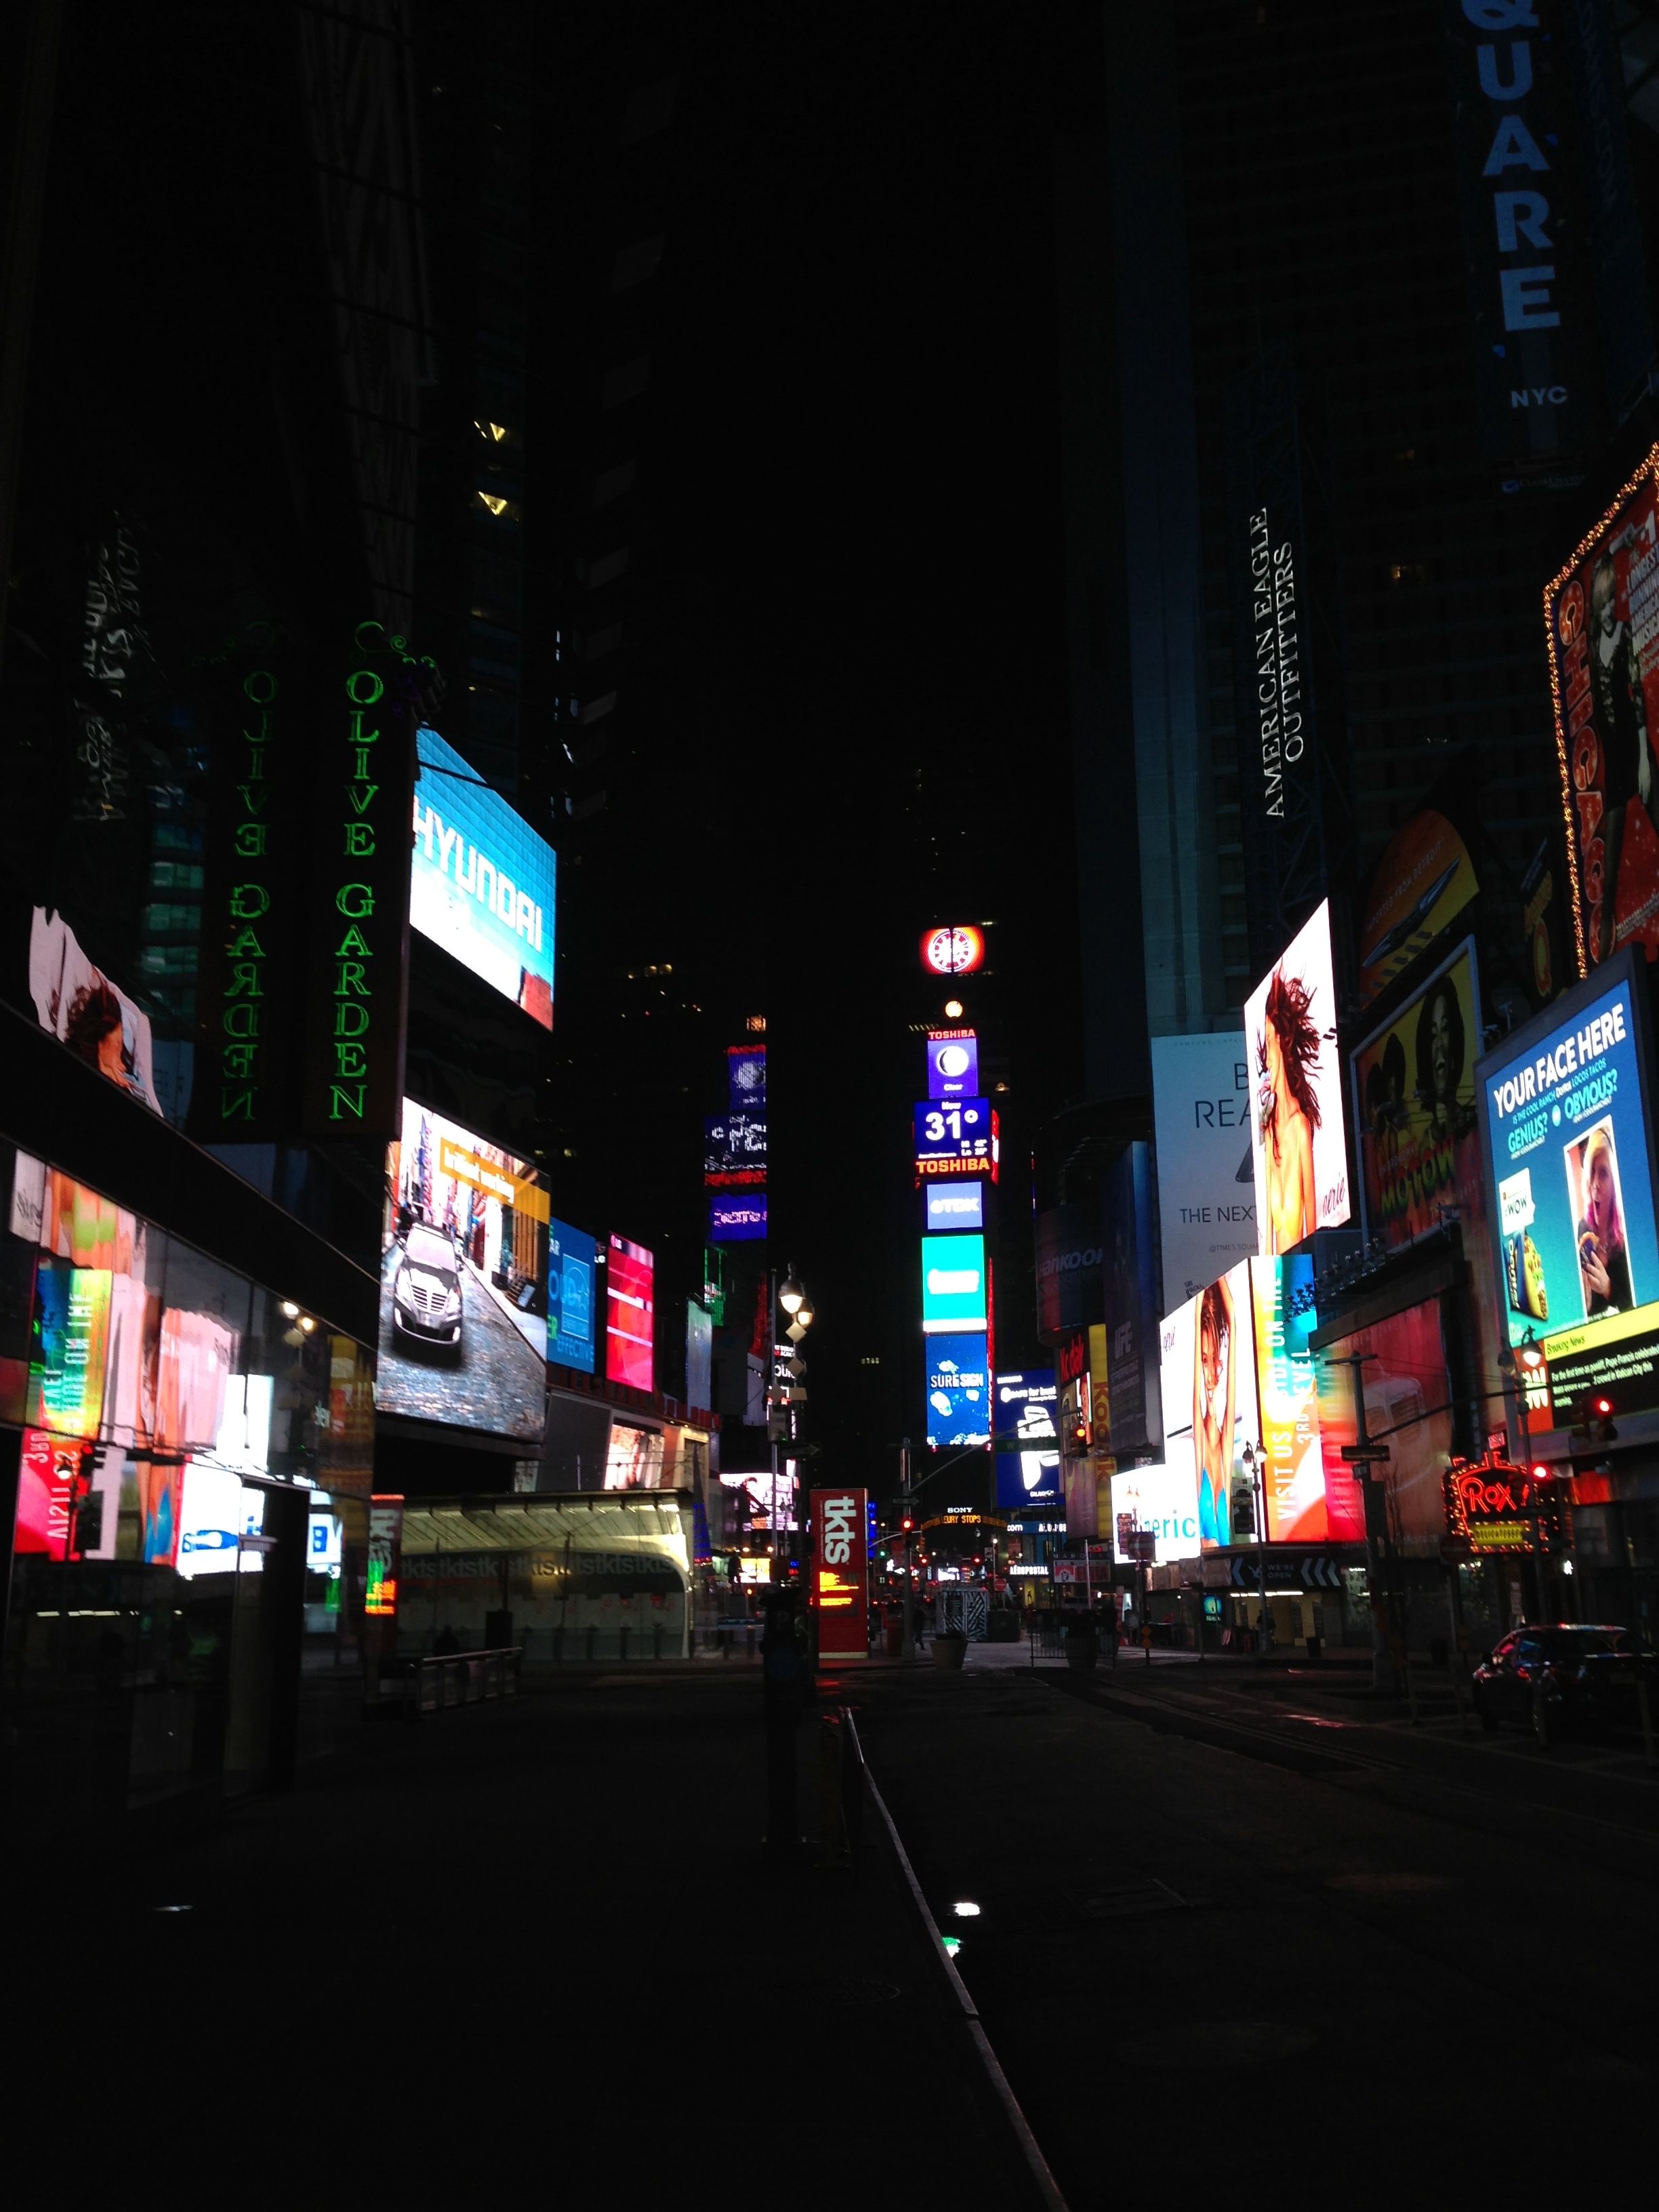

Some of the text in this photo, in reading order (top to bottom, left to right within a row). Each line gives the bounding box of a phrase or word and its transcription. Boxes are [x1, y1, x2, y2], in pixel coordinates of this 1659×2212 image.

[1511, 385, 1568, 408] NYC
[1249, 506, 1285, 819] AMERICAN EAGLE
[1273, 541, 1305, 763] OUTFITTERS
[329, 670, 384, 1120] OLIVE GARDEN
[413, 794, 542, 954] HYUNDAI
[927, 1029, 976, 1040] TOSHIBA
[1494, 1067, 1537, 1118] YOUR
[1536, 1036, 1578, 1092] FACE
[1578, 1002, 1626, 1065] HERE
[1508, 1112, 1549, 1153] GENIUS?
[1564, 1068, 1618, 1120] OBVIOUS?
[915, 1158, 990, 1173] TOSHIBA
[1180, 1205, 1256, 1223] THE NEX
[1265, 1320, 1286, 1347] ON
[1547, 1334, 1585, 1355] Breaking News
[1092, 1382, 1113, 1482] Kodk
[1271, 1431, 1293, 1458] US
[1273, 1466, 1298, 1521] VISIT
[824, 1496, 857, 1564] tkts
